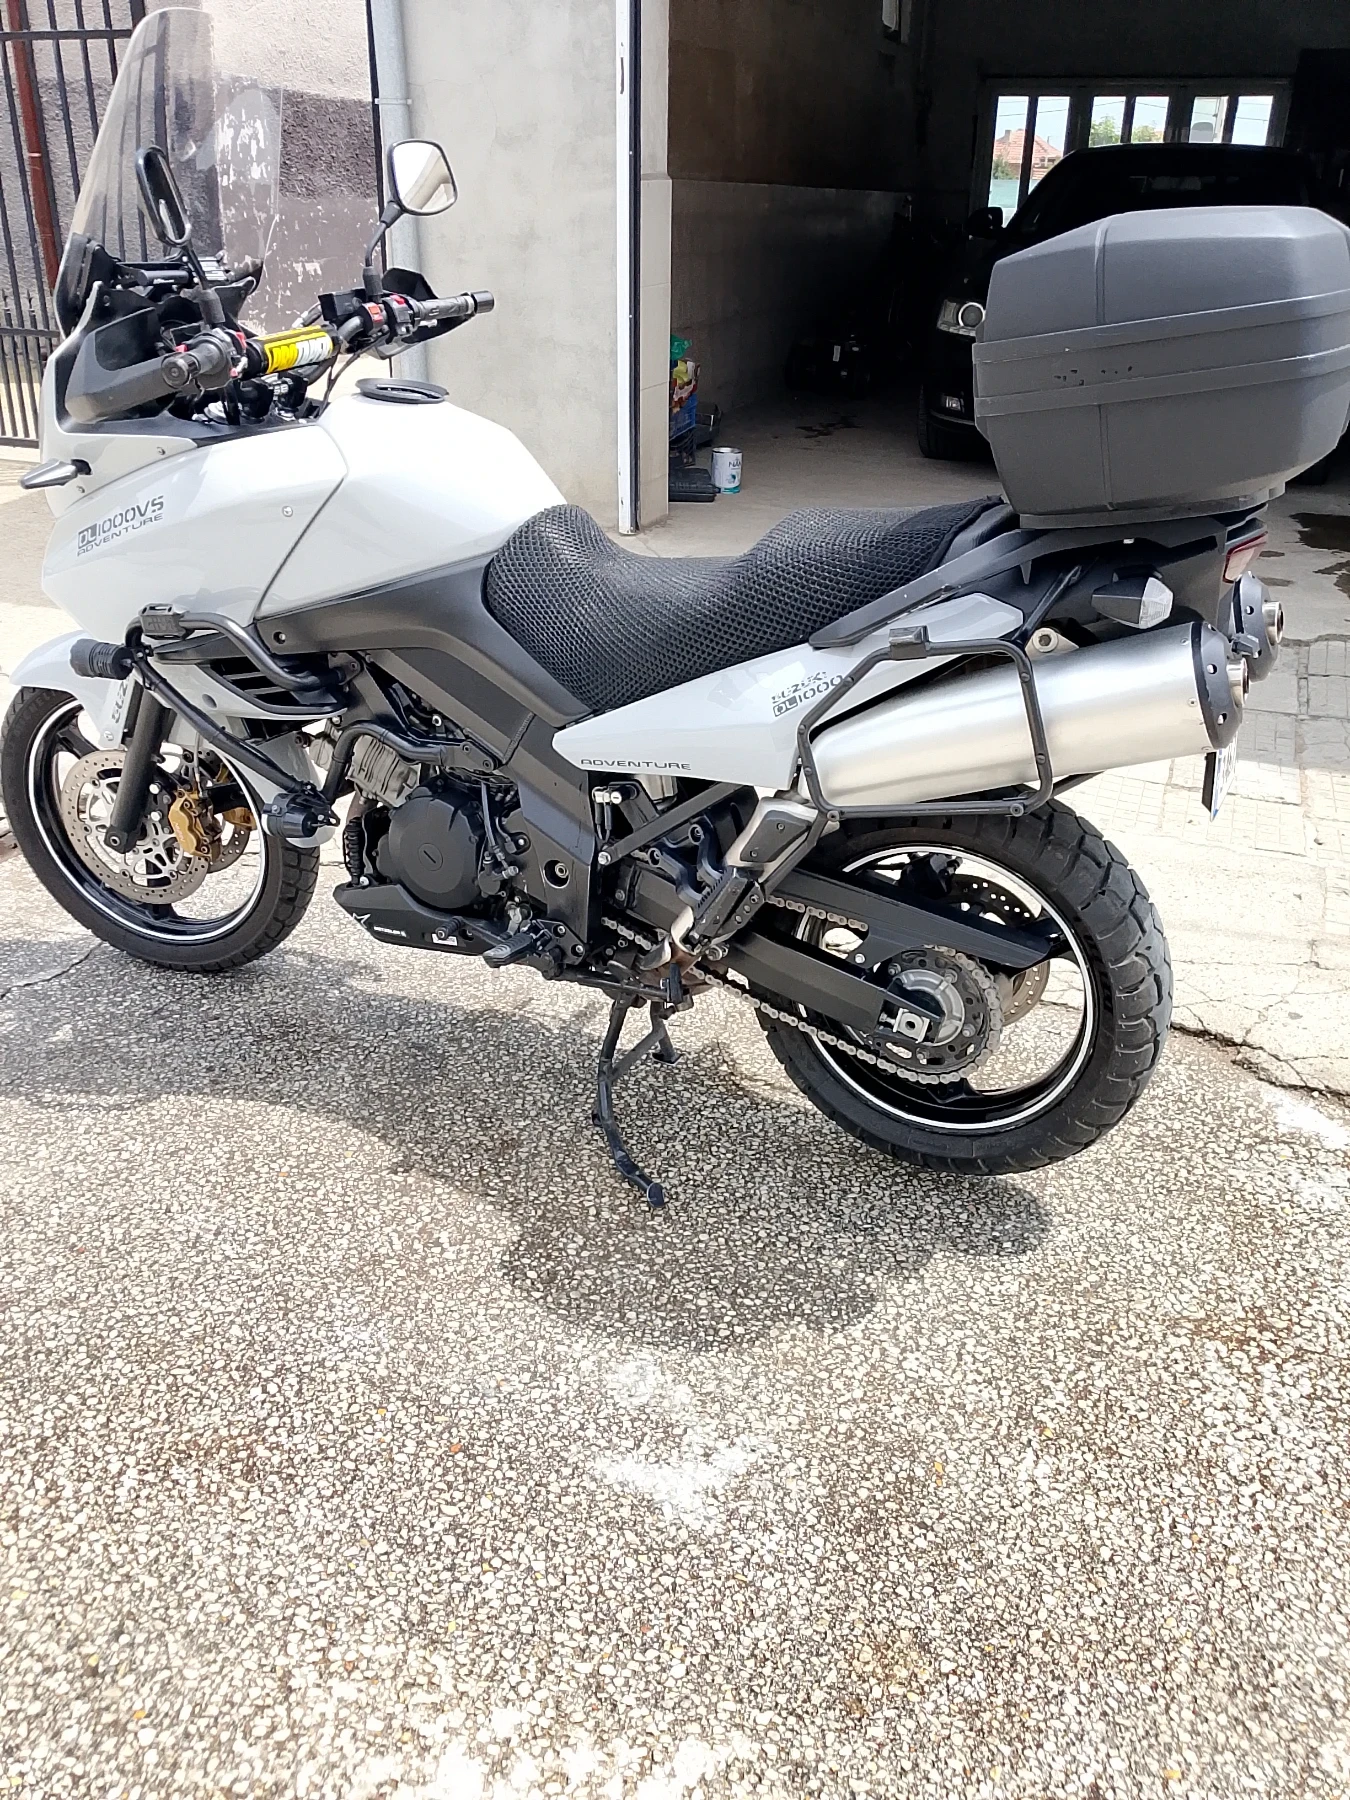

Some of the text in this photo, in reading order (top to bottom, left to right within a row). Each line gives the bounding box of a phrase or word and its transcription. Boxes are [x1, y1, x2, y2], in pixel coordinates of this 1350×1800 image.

[77, 494, 164, 550] DL1000VS
[77, 512, 164, 557] ADVENTURE
[111, 680, 128, 724] SUZ
[580, 758, 692, 771] ADVENTURE
